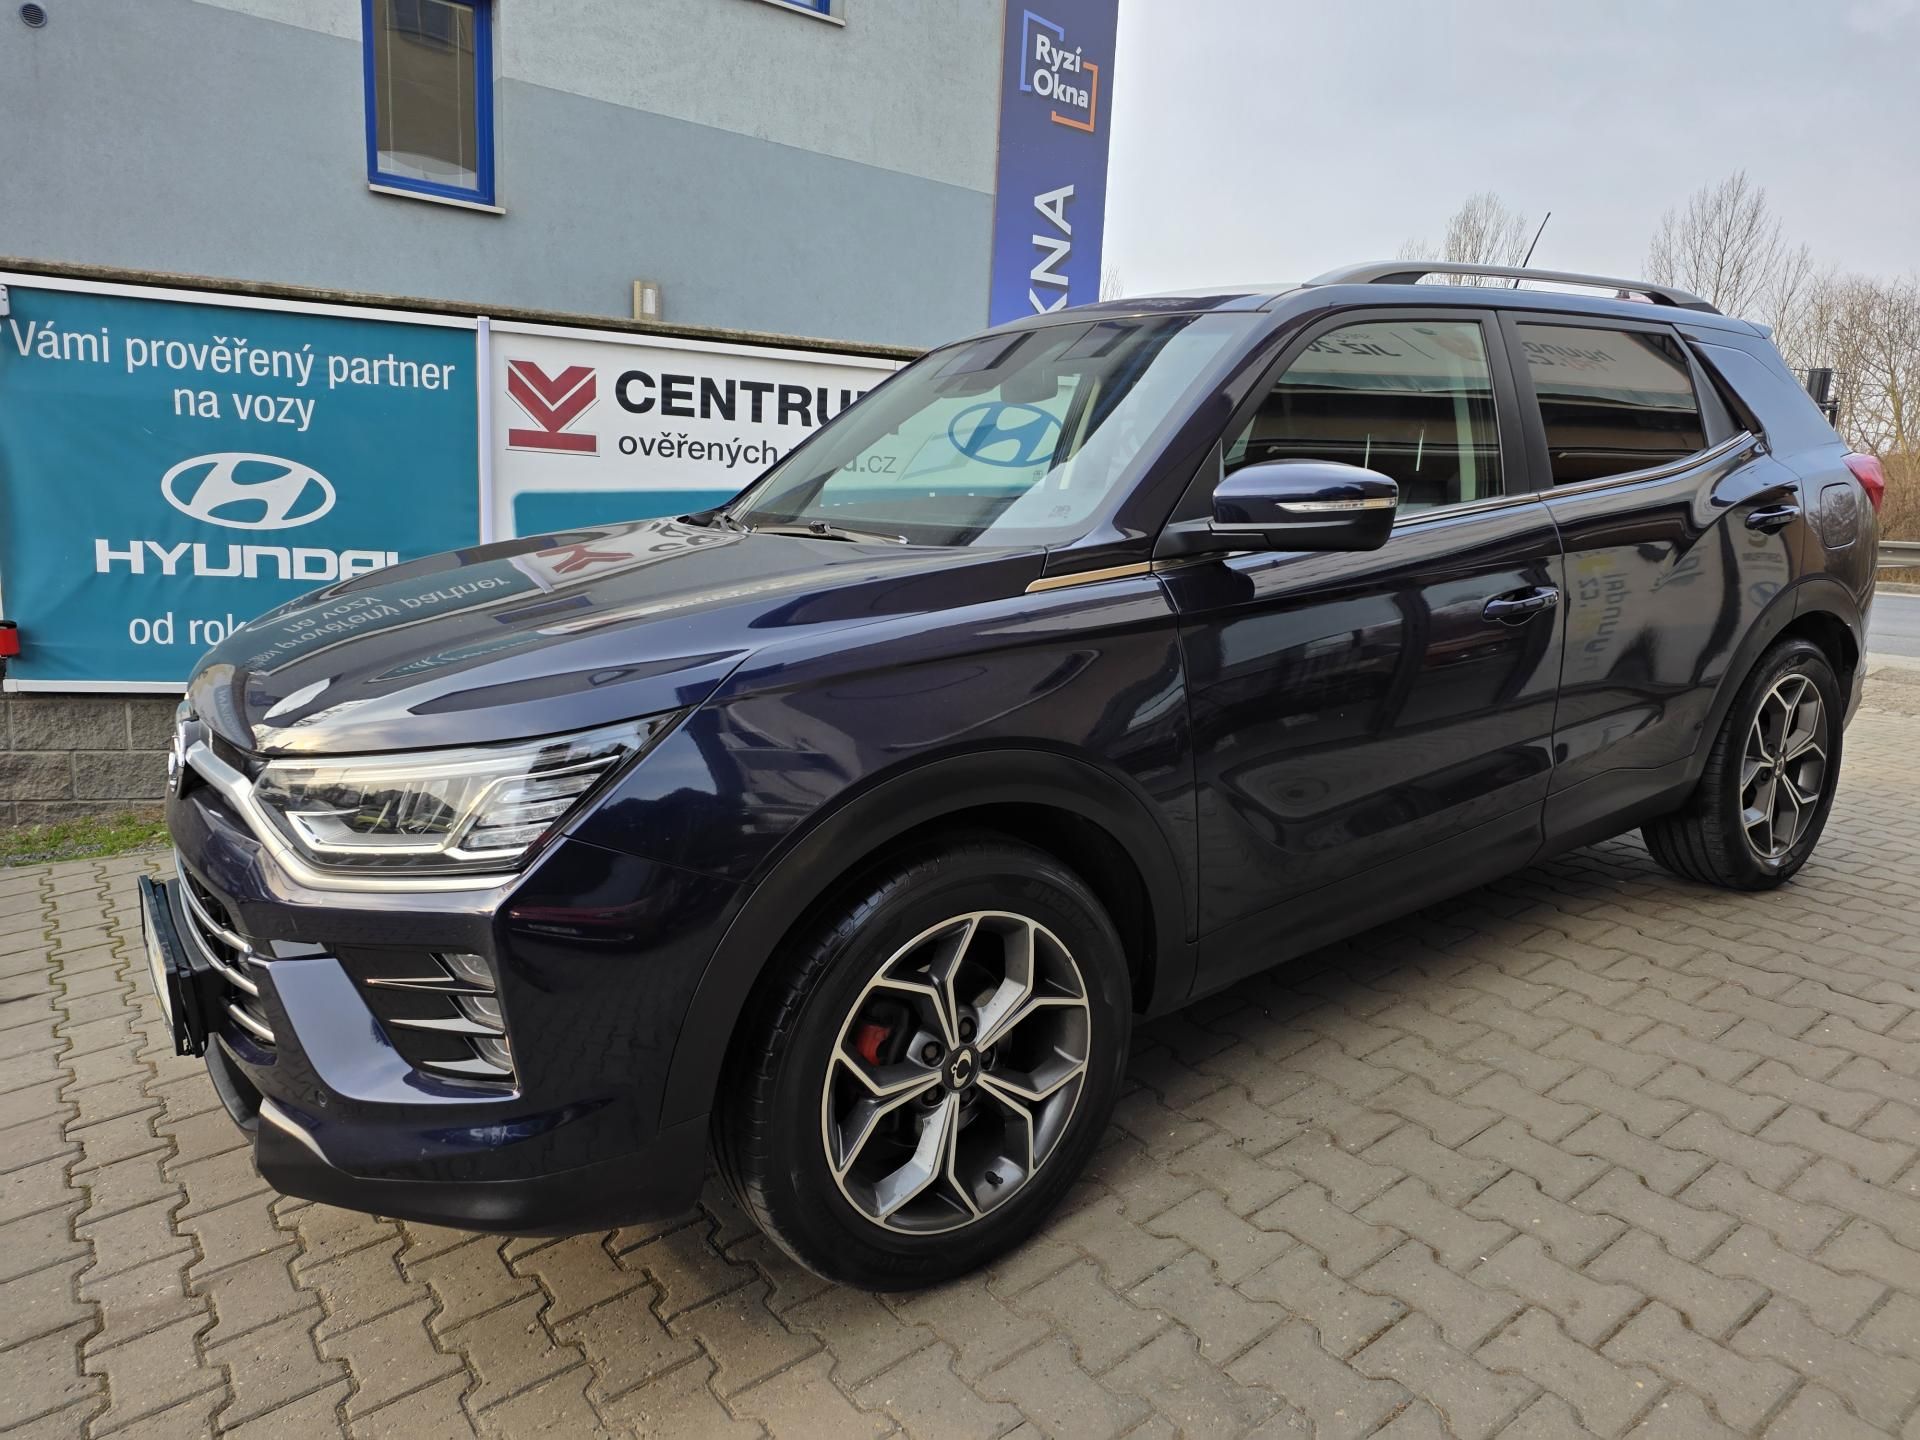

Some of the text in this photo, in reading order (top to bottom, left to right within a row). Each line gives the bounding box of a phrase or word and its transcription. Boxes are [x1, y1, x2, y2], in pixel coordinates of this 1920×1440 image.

[1035, 33, 1083, 74] Ryzí
[1032, 68, 1089, 108] Okna
[1028, 184, 1075, 315] KNA
[9, 318, 456, 390] Vámi prověřený partner
[173, 387, 315, 431] na vozy
[614, 369, 868, 428] CENTRU
[618, 432, 778, 469] ověřených
[129, 611, 247, 646] od rok
